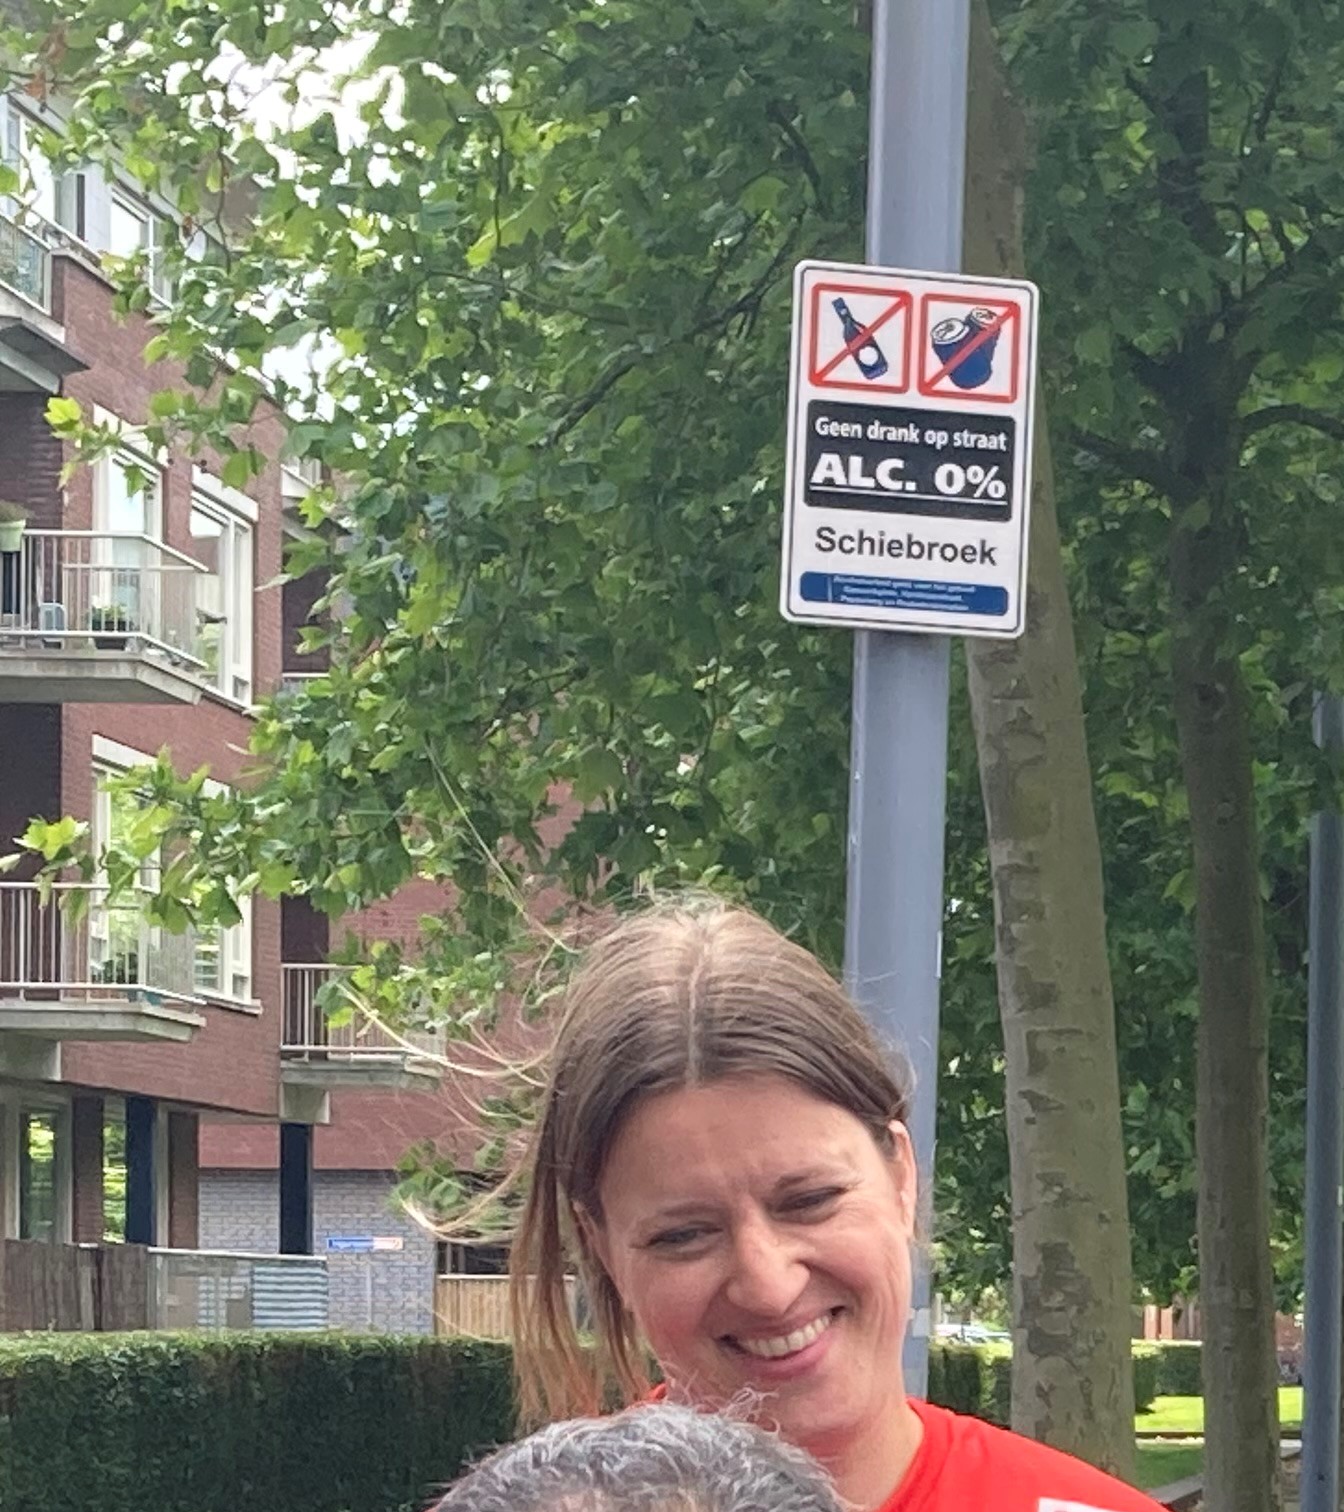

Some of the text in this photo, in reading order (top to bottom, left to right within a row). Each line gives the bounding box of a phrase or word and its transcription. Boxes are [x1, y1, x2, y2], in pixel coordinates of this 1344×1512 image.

[815, 416, 1007, 451] Geen drank op straat
[811, 452, 1006, 499] ALC. 0%
[815, 526, 997, 566] Schiebroek
